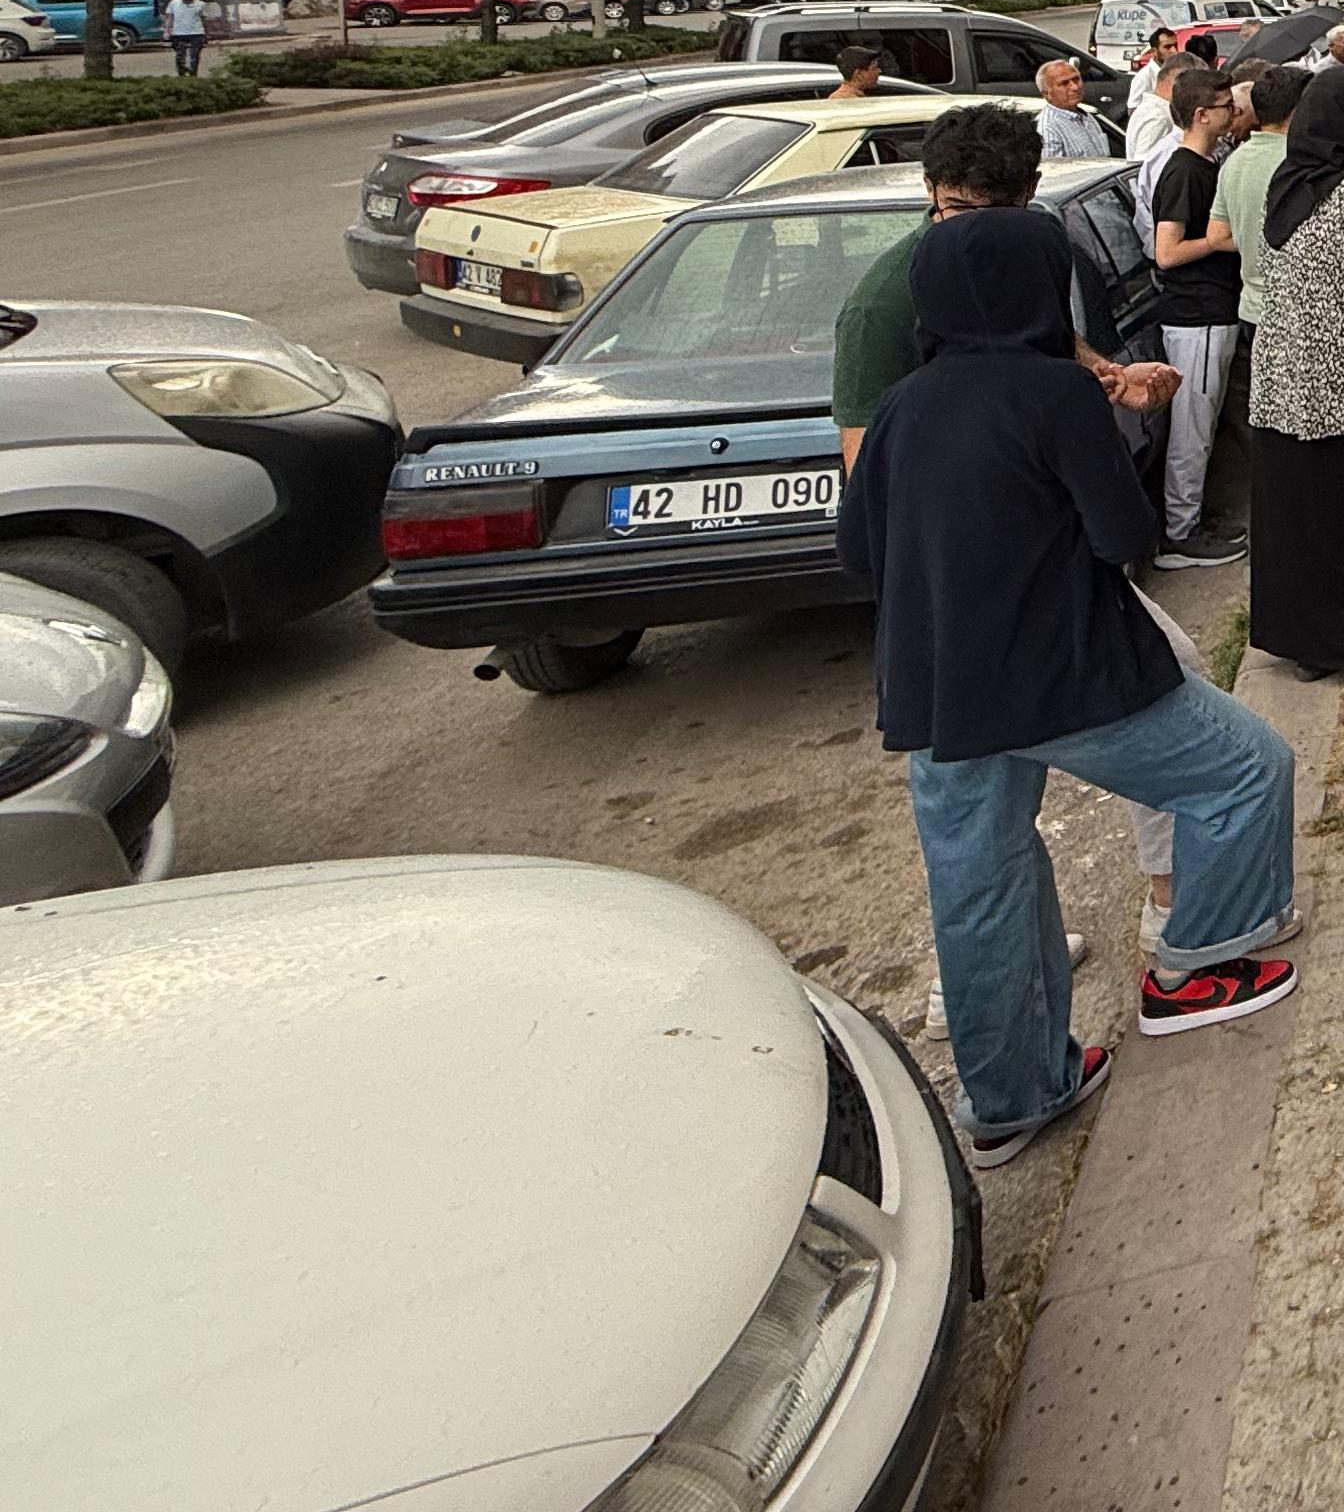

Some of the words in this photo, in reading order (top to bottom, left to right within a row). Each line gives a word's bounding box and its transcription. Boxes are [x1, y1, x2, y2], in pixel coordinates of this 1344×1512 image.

[424, 462, 520, 482] RENAULT
[523, 460, 539, 476] 9
[613, 508, 629, 520] TR
[631, 488, 673, 520] 42
[702, 481, 743, 516] HD
[771, 474, 833, 509] 090
[691, 517, 742, 531] KAYLA
